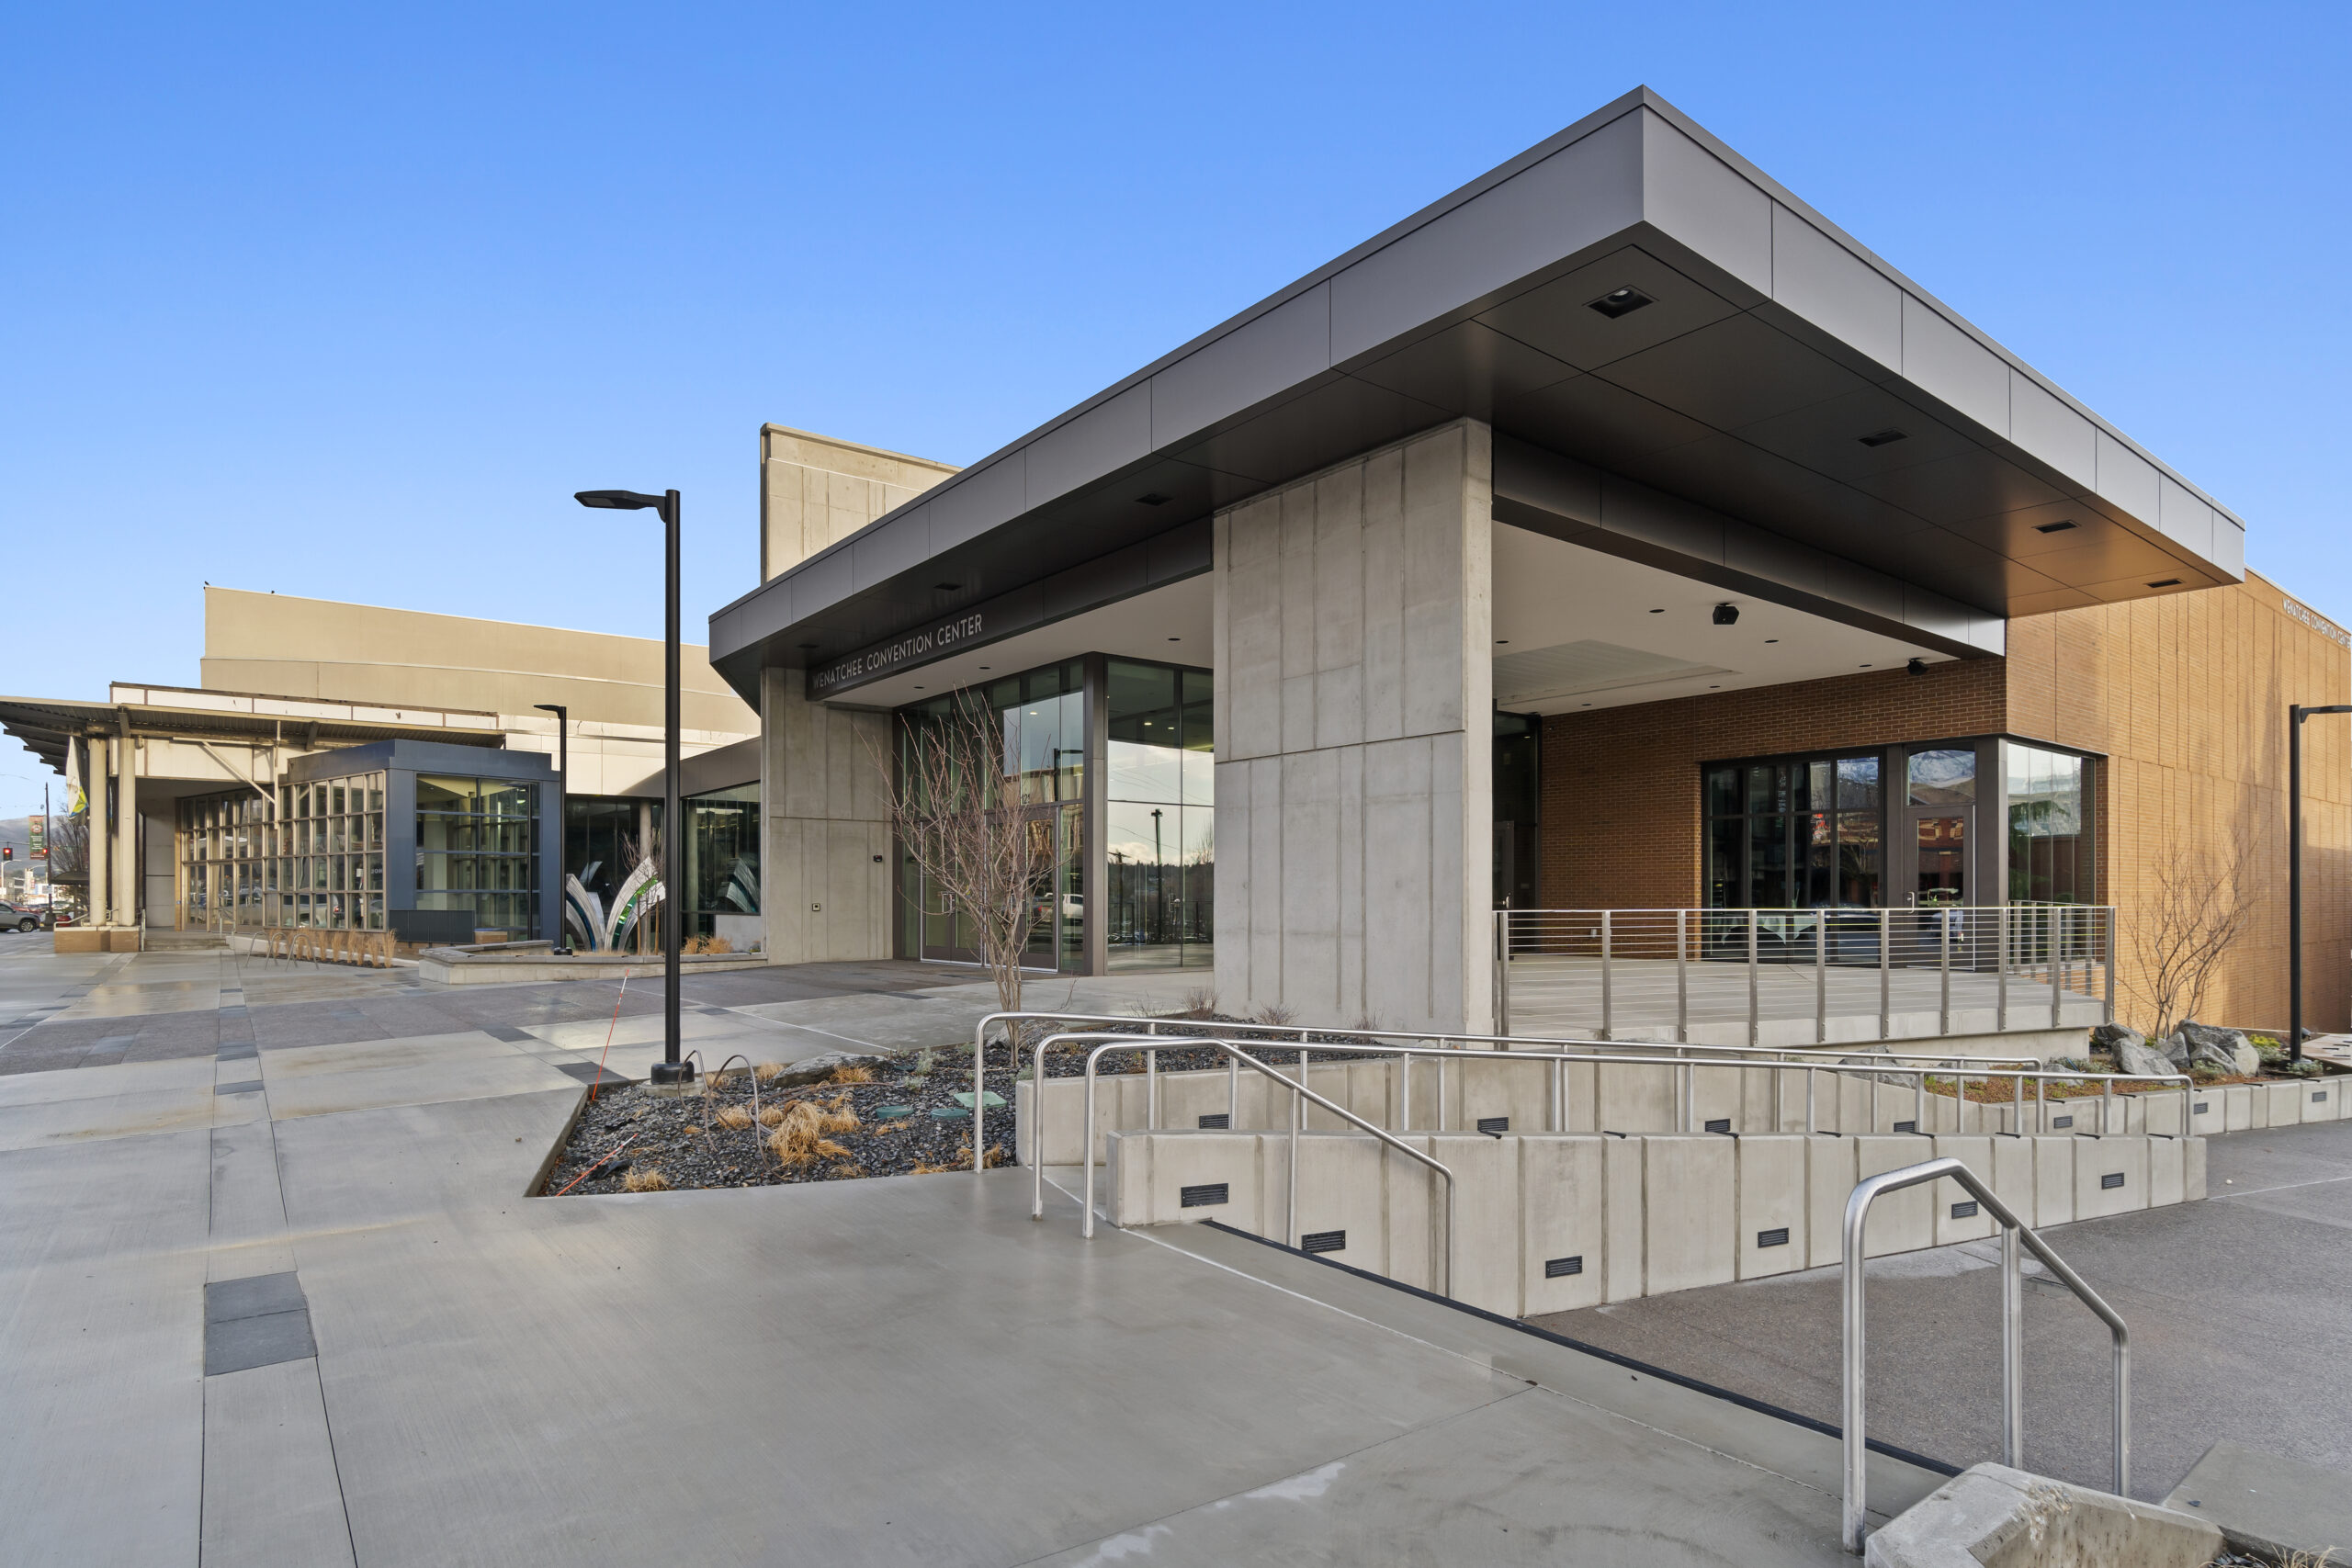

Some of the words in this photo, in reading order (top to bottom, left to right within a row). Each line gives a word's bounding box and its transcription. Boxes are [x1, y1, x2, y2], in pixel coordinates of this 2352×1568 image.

[812, 658, 862, 690] WENATCHEE
[866, 632, 933, 671] CONVENTION
[937, 614, 982, 646] CENTER
